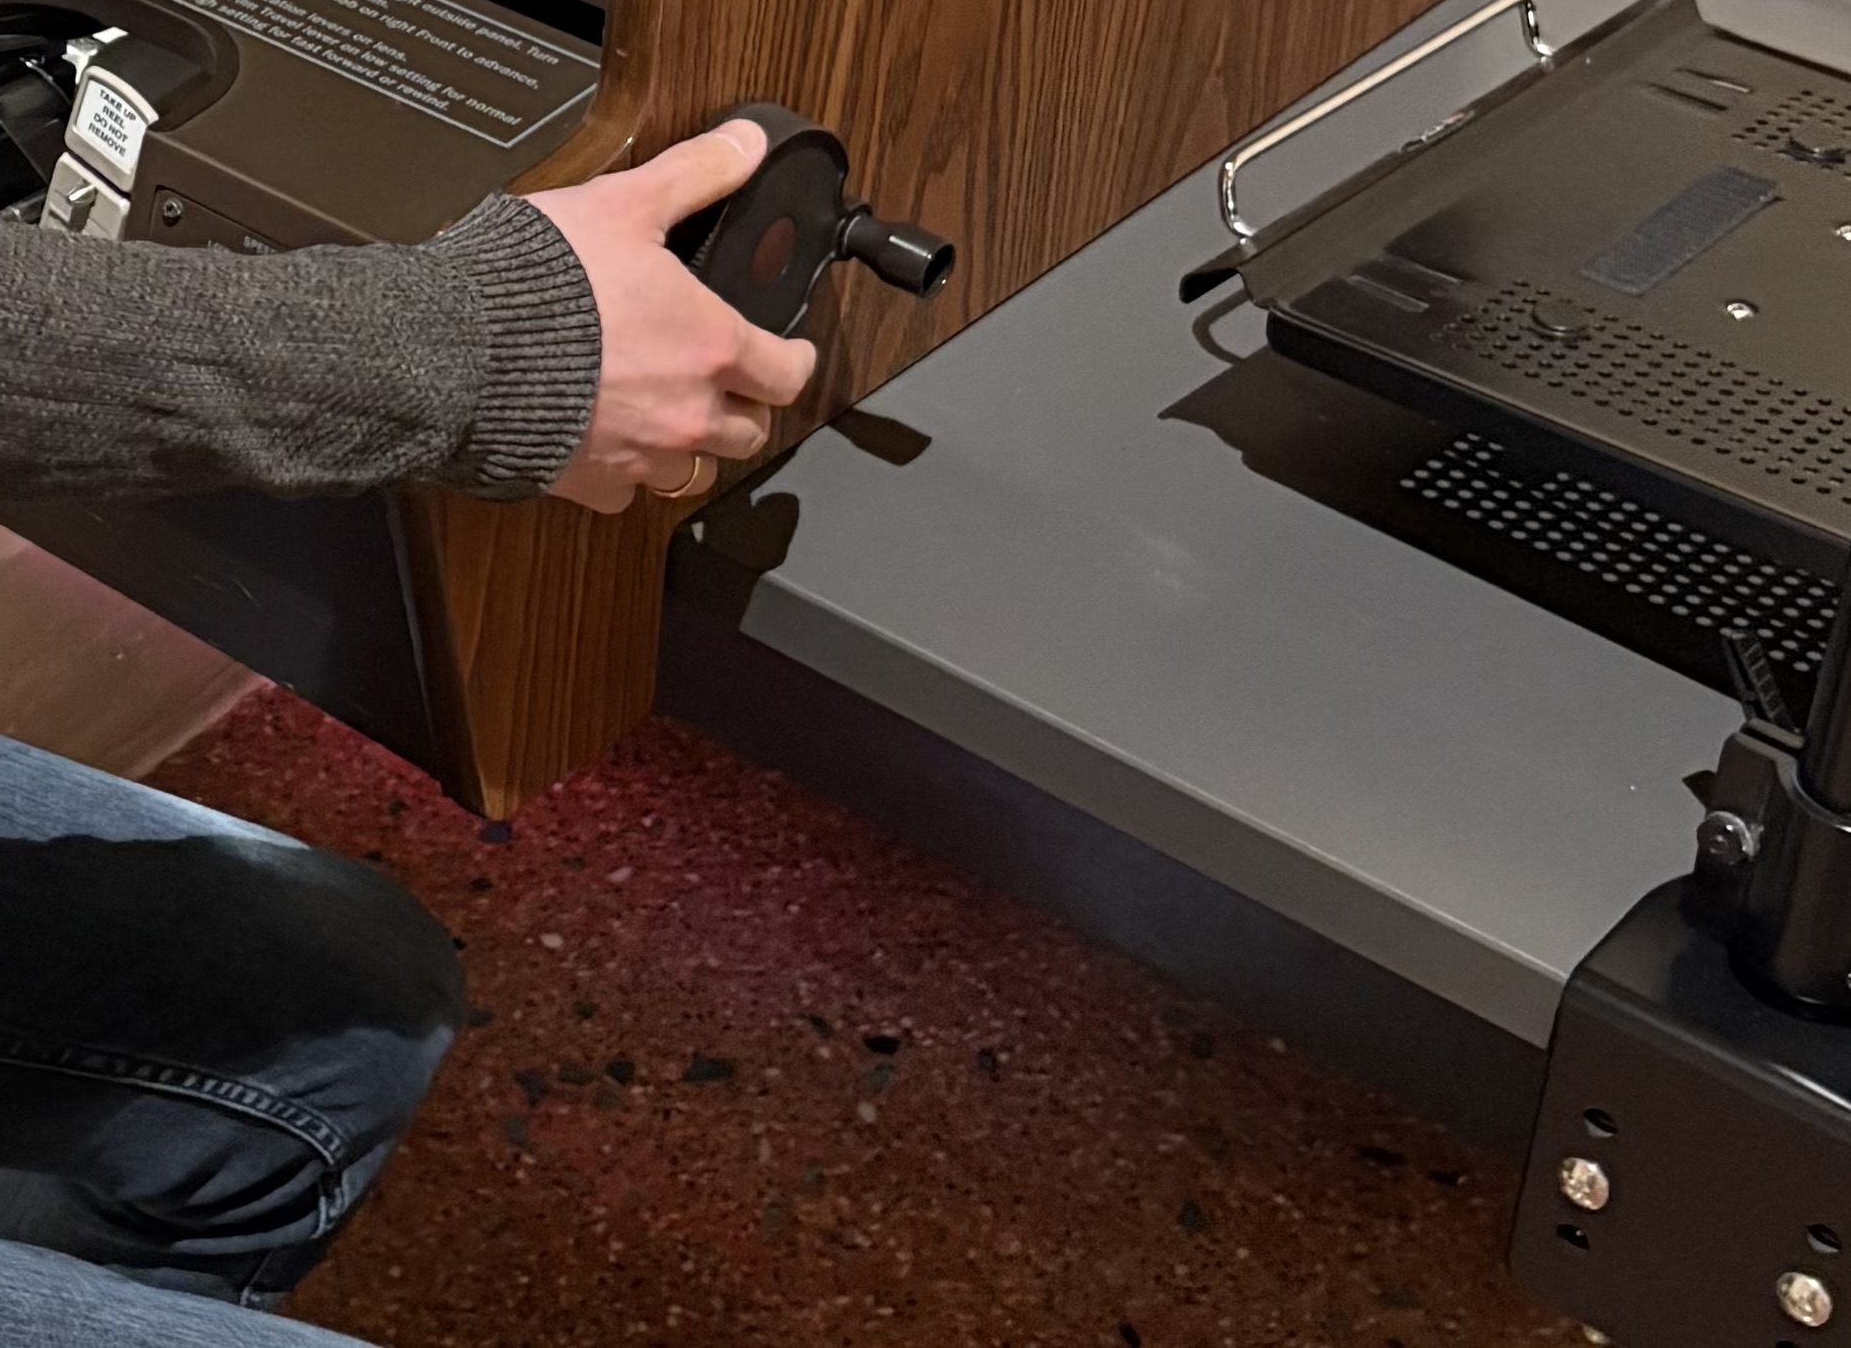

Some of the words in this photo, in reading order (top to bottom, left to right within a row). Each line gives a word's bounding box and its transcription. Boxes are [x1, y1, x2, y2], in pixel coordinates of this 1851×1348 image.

[422, 3, 476, 29] outside
[218, 5, 268, 30] setting
[321, 49, 379, 77] forward
[100, 89, 122, 112] TAKE
[123, 108, 137, 122] UP
[388, 64, 442, 91] setting
[465, 98, 521, 124] normal
[93, 112, 108, 128] DO
[108, 124, 128, 143] NOT
[102, 105, 126, 130] REEL
[88, 122, 126, 157] REMOVE
